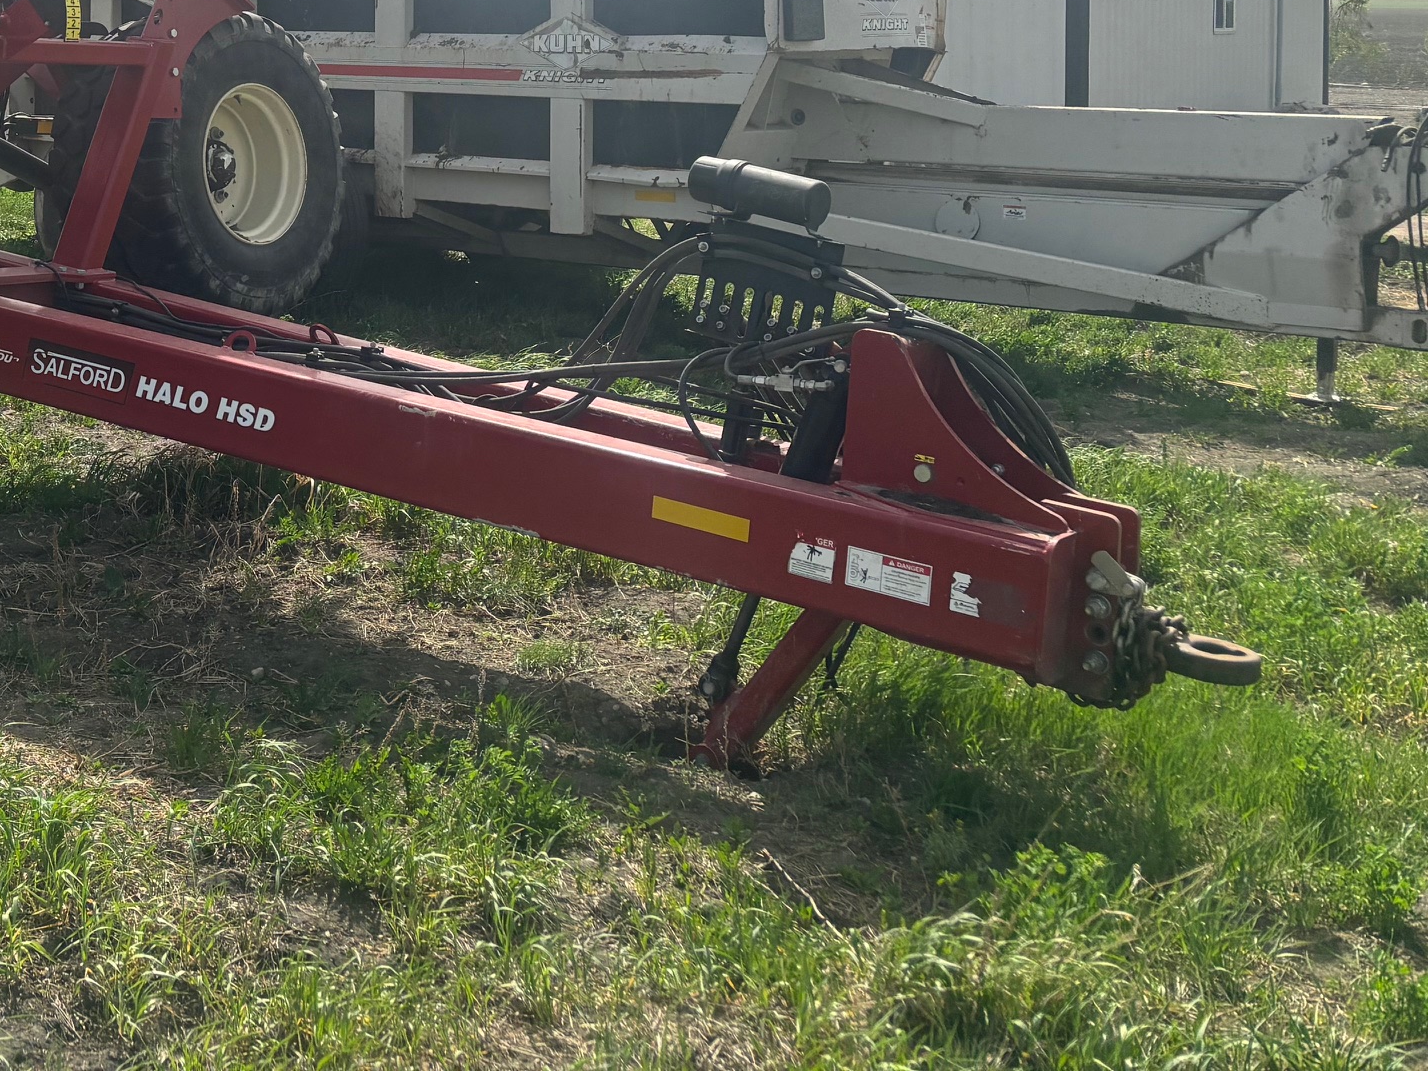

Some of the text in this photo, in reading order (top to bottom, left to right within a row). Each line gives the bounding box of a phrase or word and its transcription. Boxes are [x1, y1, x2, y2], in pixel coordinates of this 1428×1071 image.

[71, 8, 76, 16] 3
[71, 19, 76, 27] 2
[862, 18, 909, 31] KNIGHT
[533, 34, 601, 54] KUHN
[522, 70, 606, 84] KNIG
[30, 348, 126, 393] SALFORD
[135, 375, 276, 432] HALO HSD
[896, 561, 925, 574] DANGER
